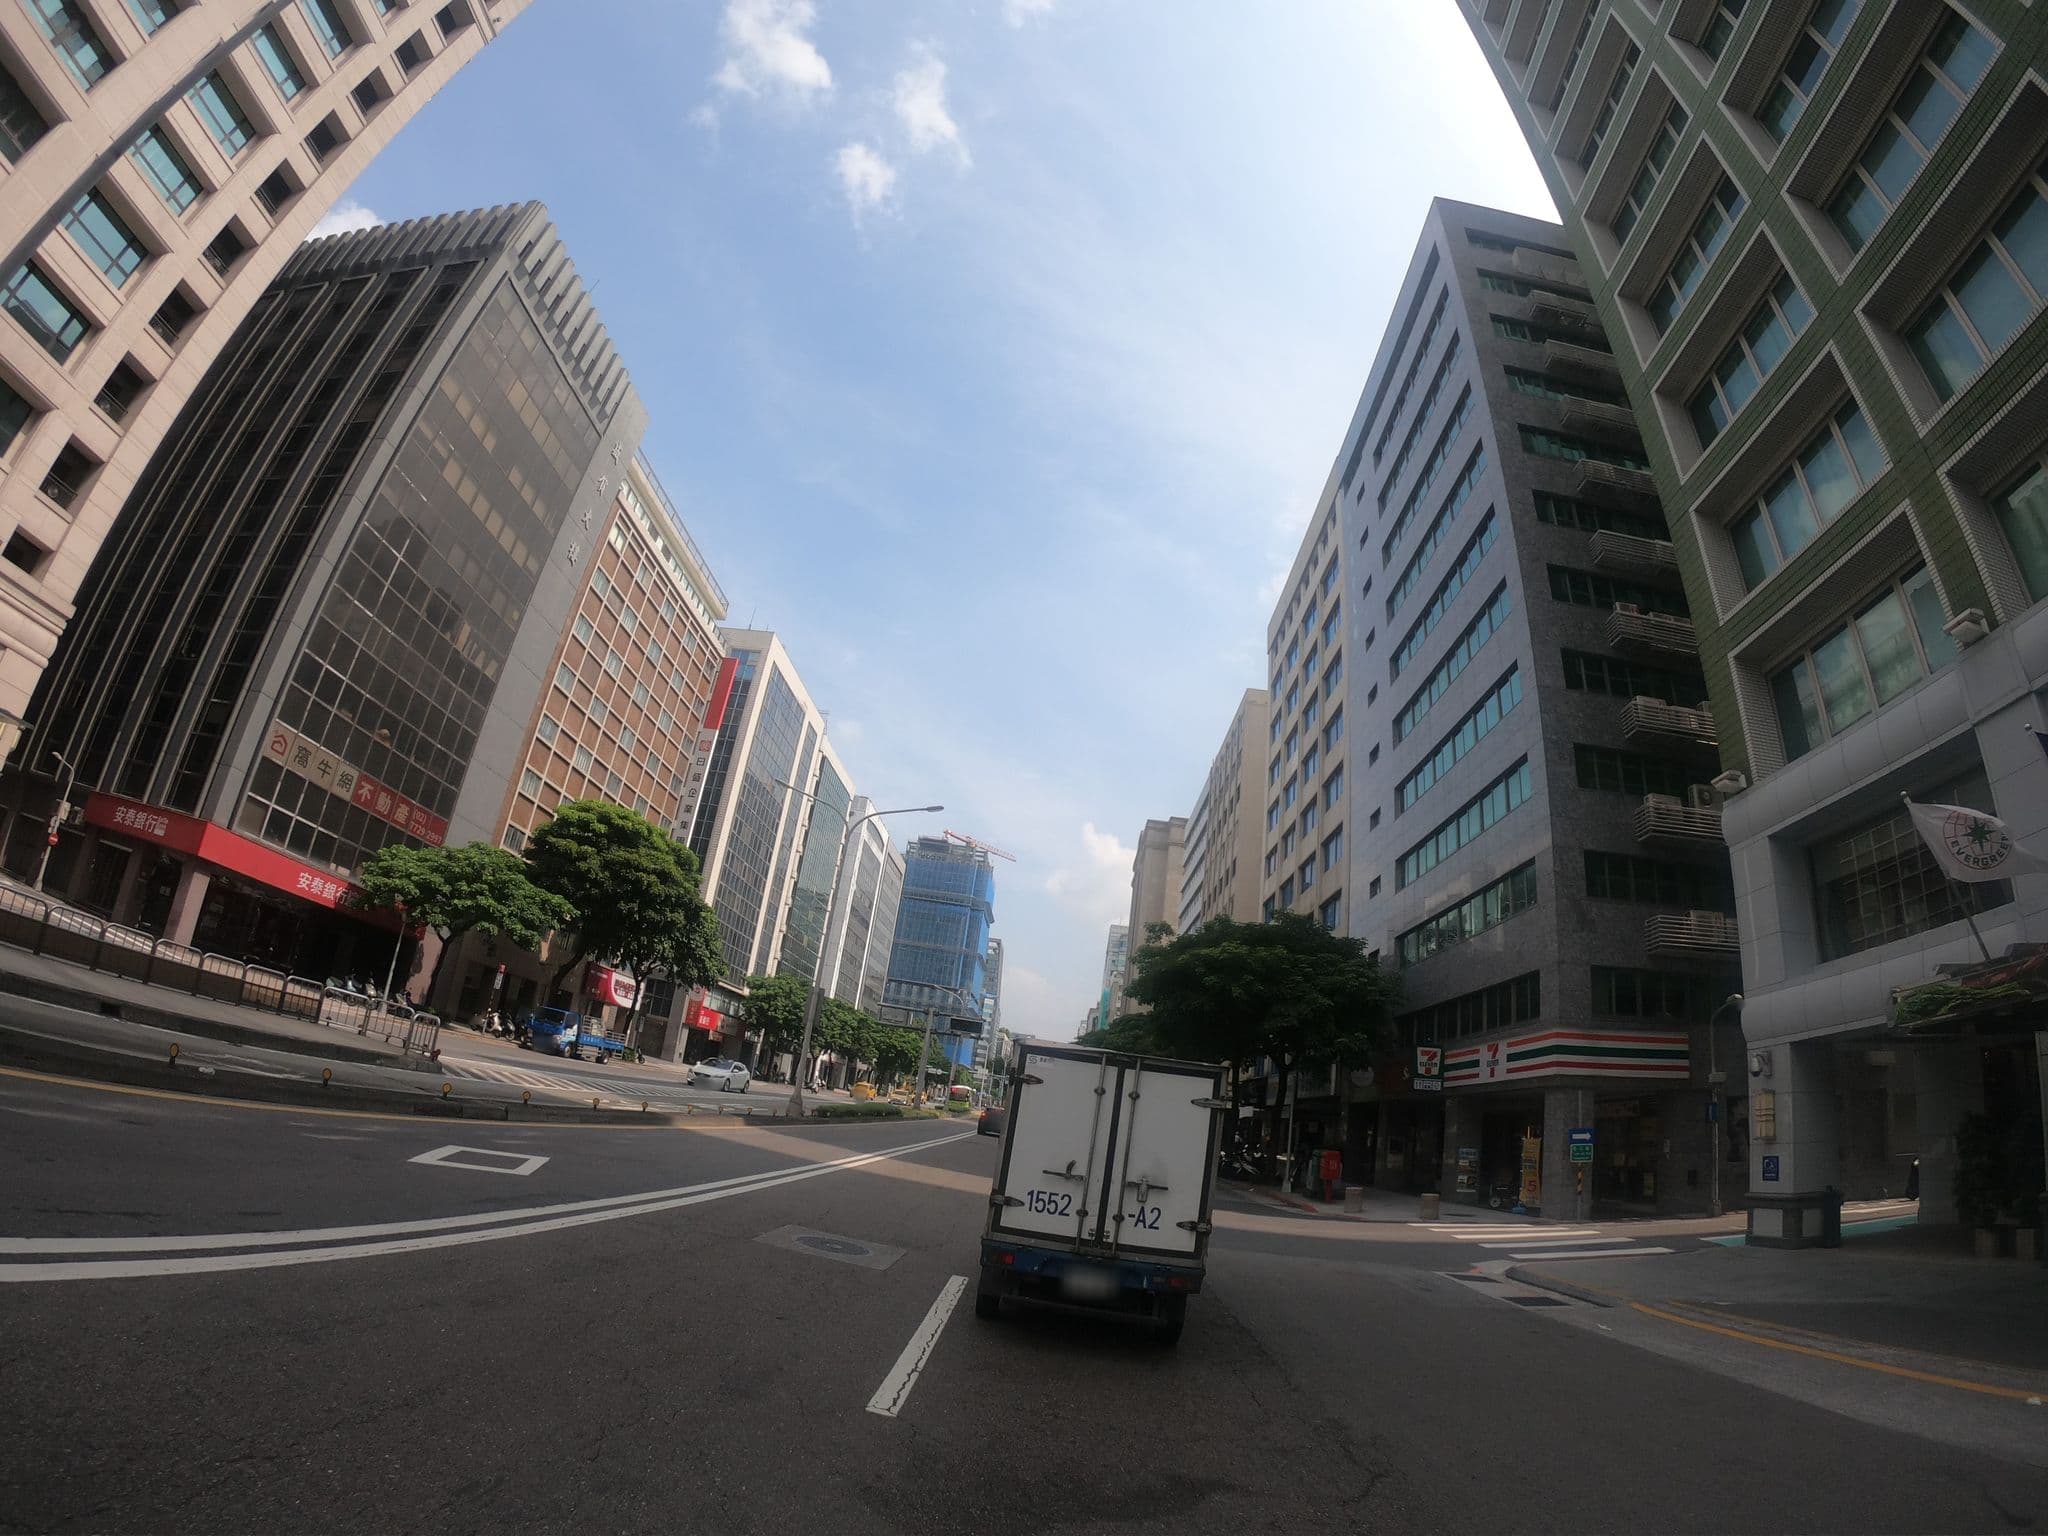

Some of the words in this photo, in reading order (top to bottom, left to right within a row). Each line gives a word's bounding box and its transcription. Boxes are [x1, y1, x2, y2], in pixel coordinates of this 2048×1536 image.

[113, 806, 159, 833] 安泰銀行
[358, 781, 410, 825] 不動產
[1950, 833, 2010, 867] EVERGREEN
[296, 872, 347, 905] 安泰銀行
[1026, 1189, 1073, 1217] 1552
